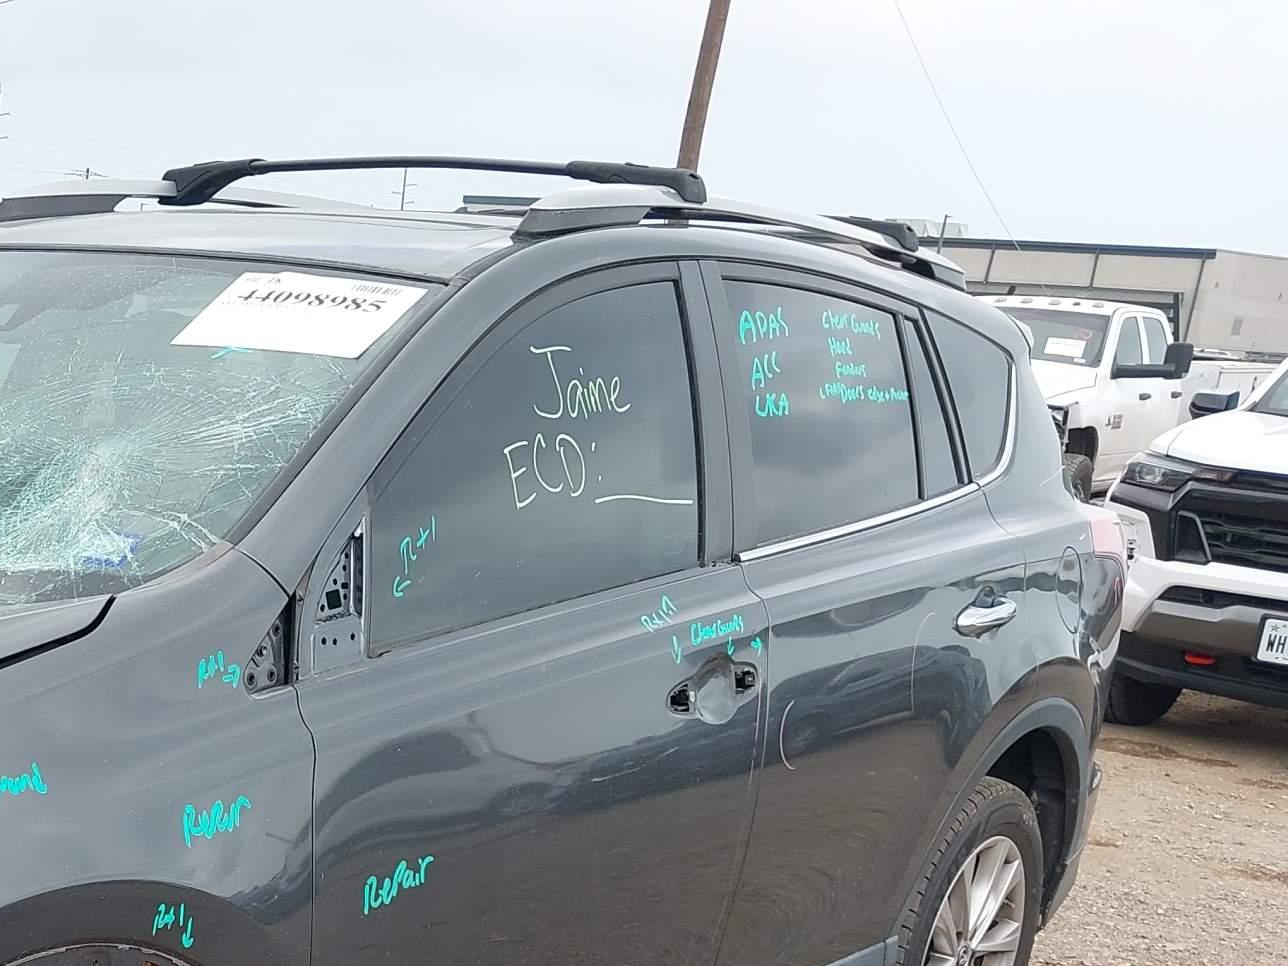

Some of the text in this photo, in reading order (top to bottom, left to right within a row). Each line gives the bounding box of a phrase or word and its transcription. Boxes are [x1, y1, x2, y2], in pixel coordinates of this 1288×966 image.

[237, 288, 388, 312] 44098985
[739, 306, 789, 345] ADAS
[529, 346, 631, 419] Jaime
